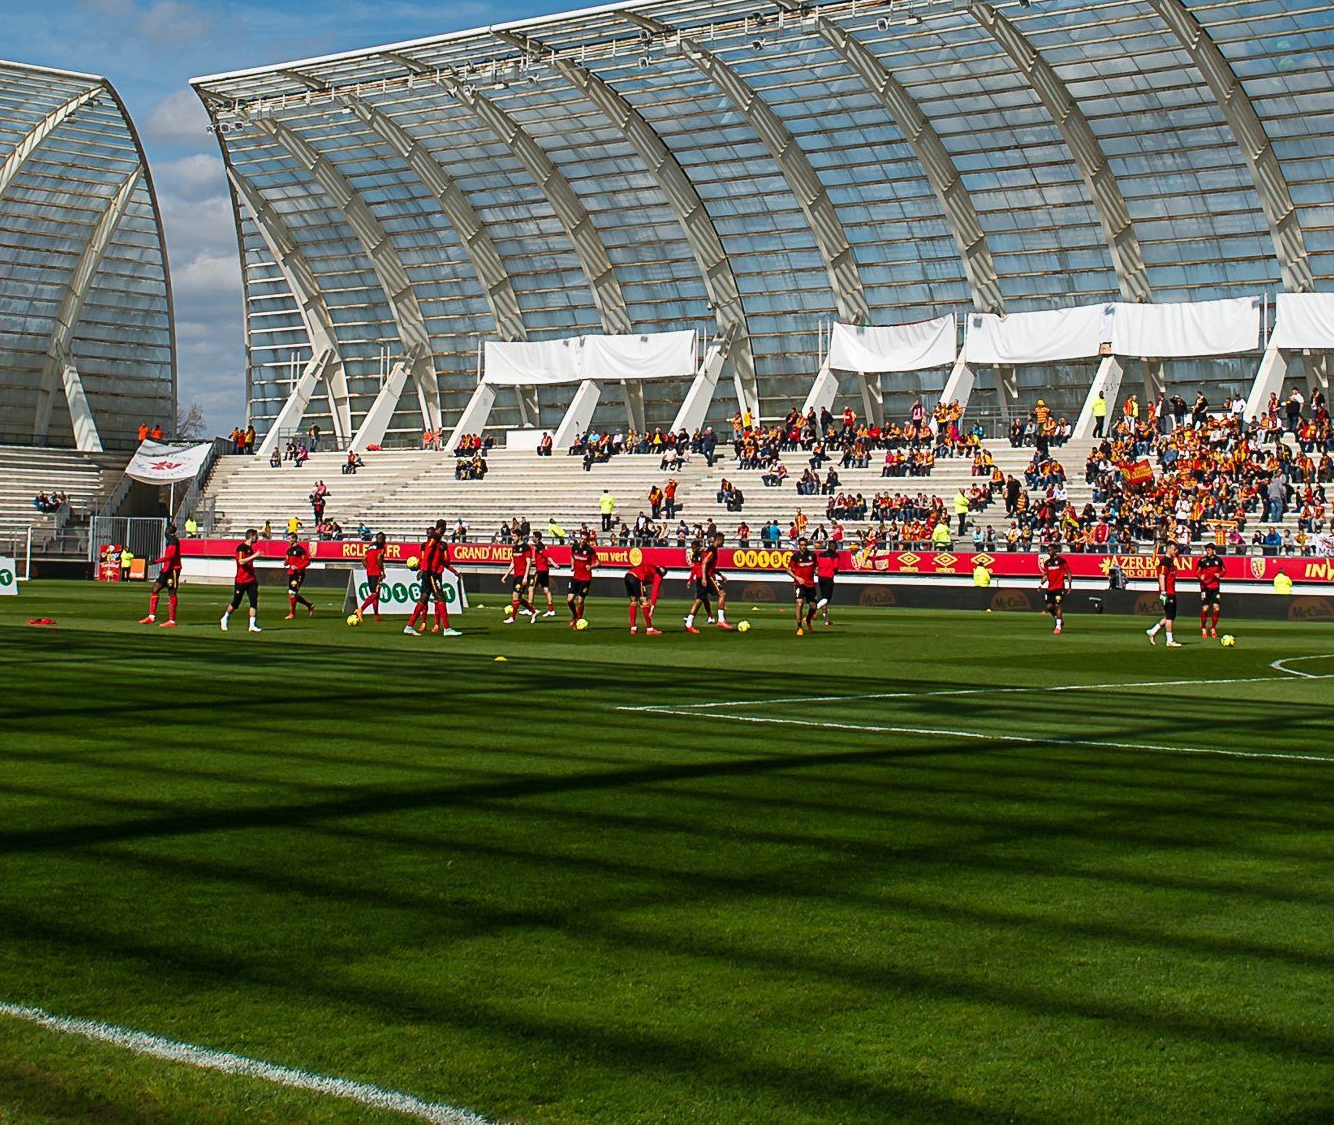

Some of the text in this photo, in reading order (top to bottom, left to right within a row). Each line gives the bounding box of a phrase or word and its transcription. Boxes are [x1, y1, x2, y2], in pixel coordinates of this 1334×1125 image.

[610, 551, 628, 562] vert
[733, 550, 793, 569] UNIBE
[1109, 555, 1193, 570] AZERBAAN
[900, 565, 919, 573] umbro
[358, 582, 455, 603] UNIBT
